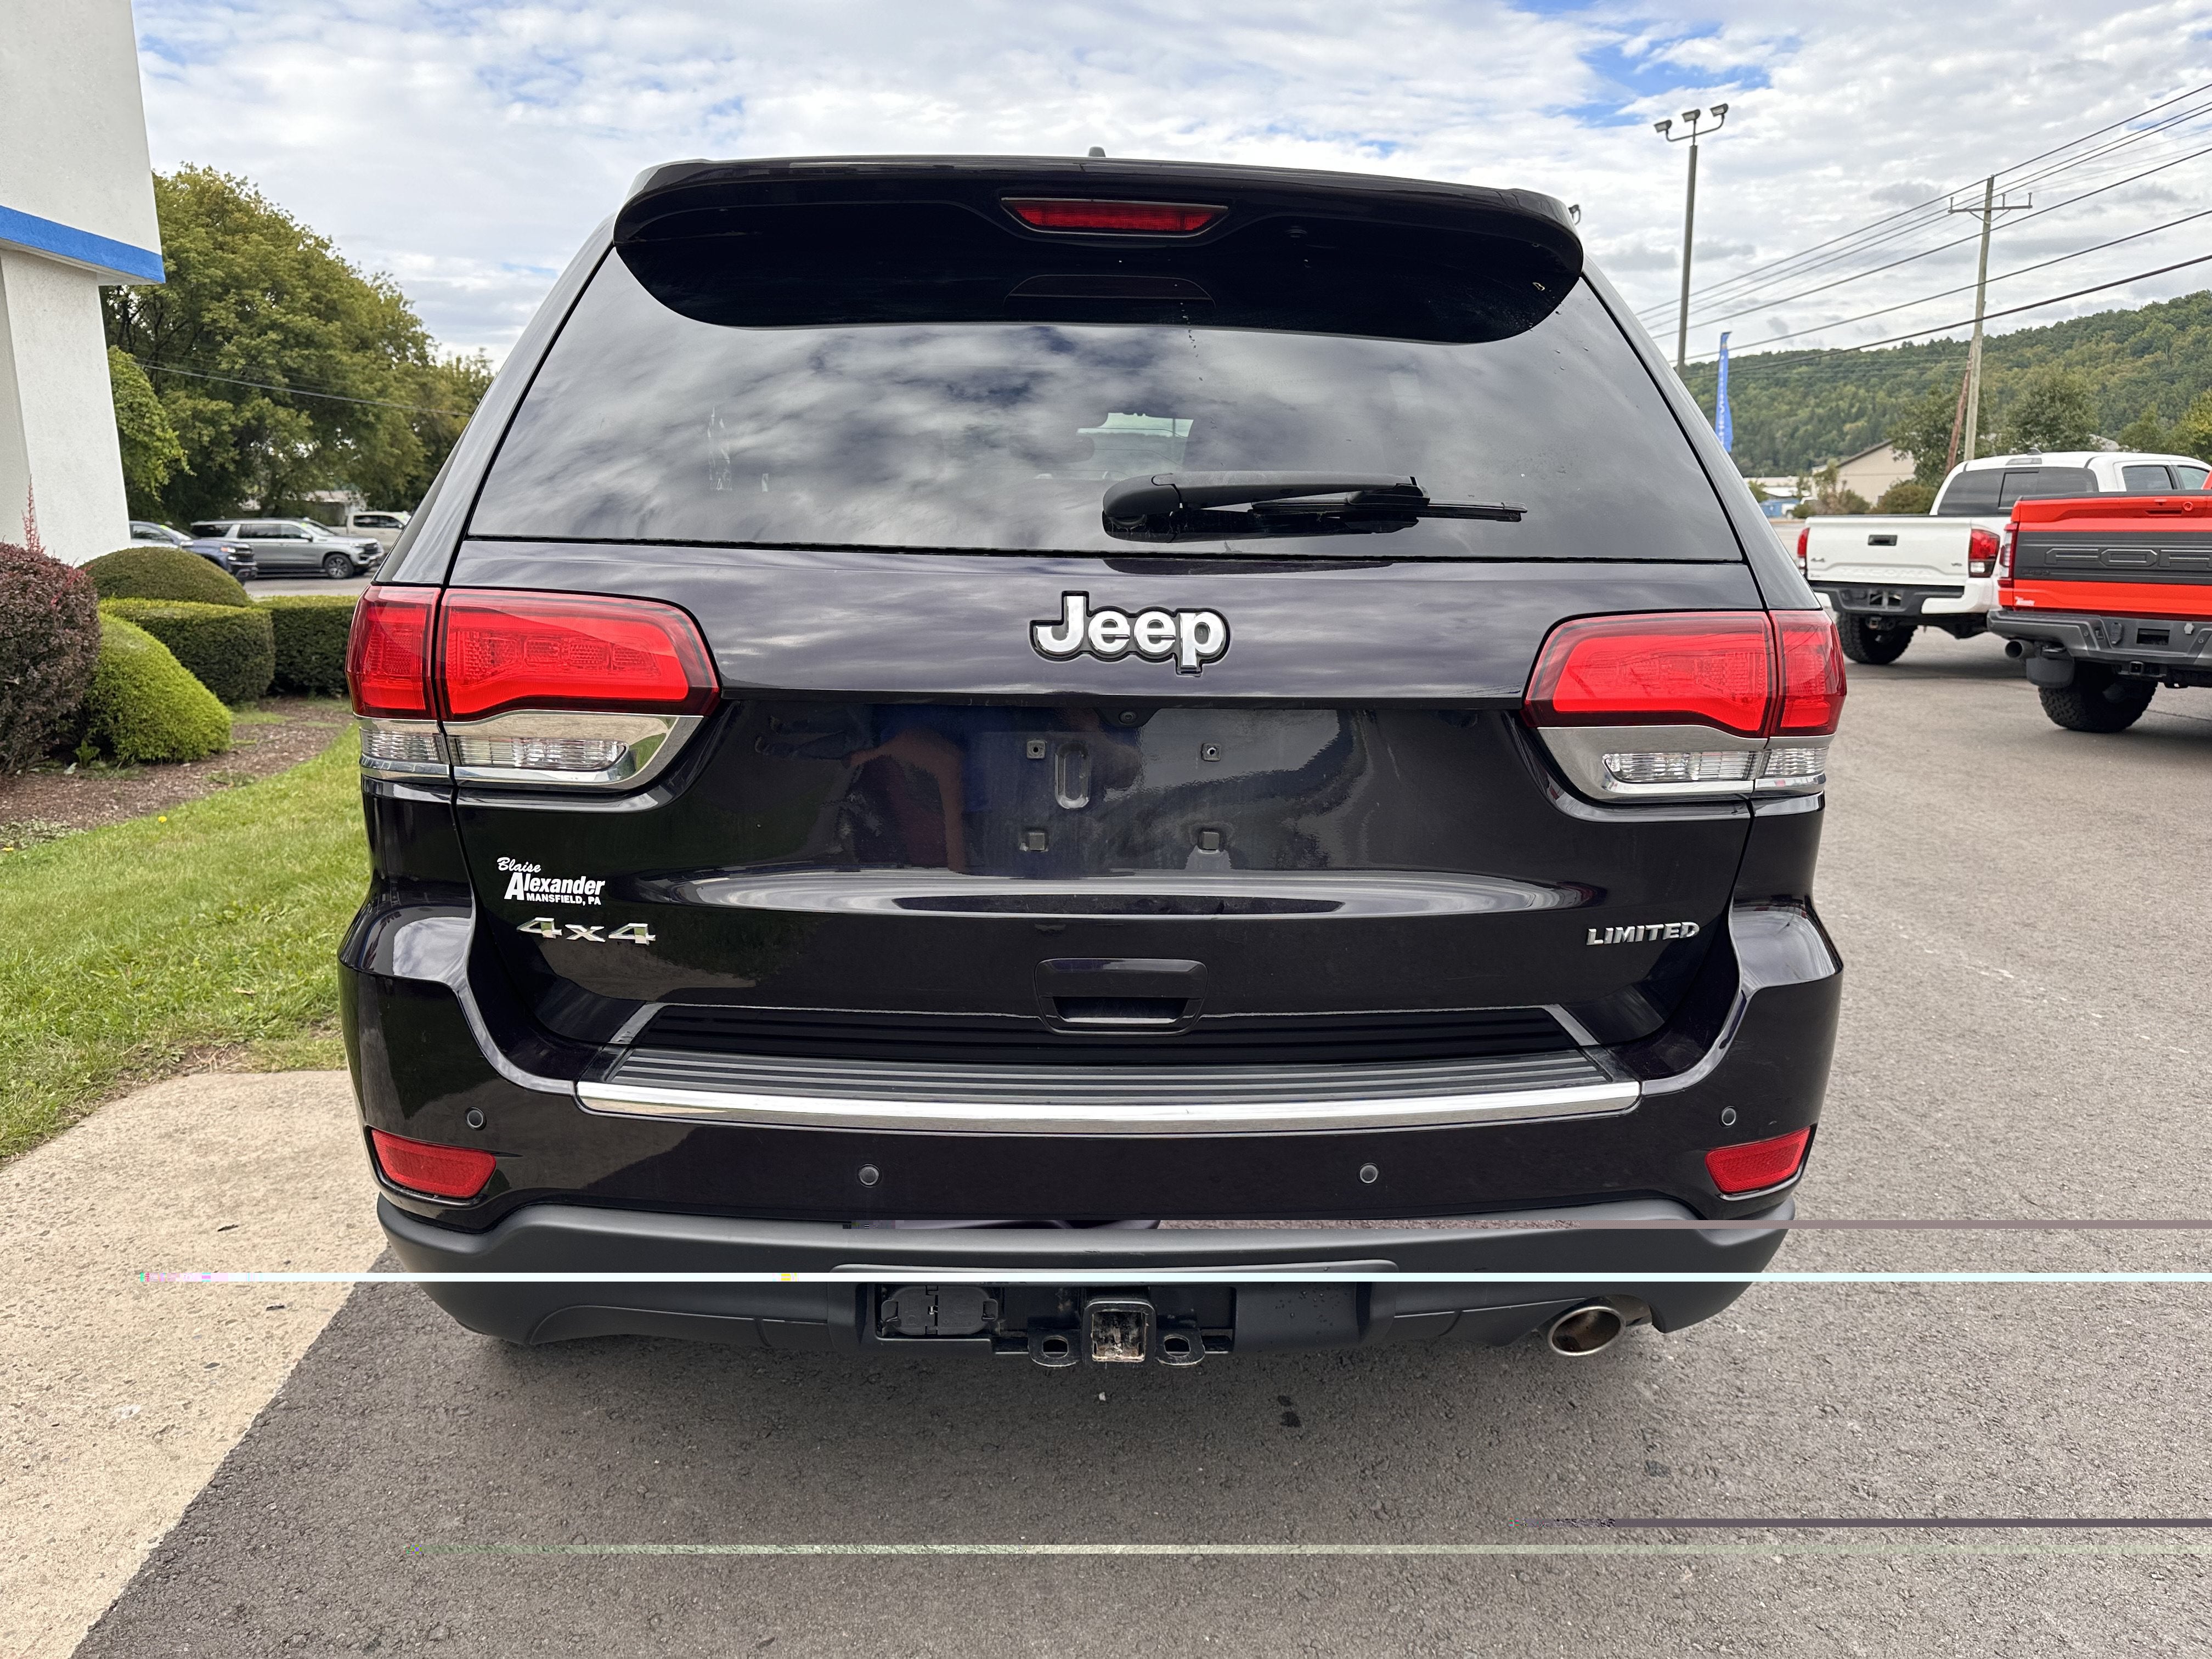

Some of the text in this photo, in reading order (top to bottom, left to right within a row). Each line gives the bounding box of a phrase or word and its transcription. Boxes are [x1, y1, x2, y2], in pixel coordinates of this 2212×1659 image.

[1032, 592, 1228, 673] Jeep
[496, 857, 541, 873] Blaise
[504, 872, 606, 901] Alexander
[526, 892, 602, 906] MANSFIELD, PA
[1585, 922, 1700, 946] LIMITED
